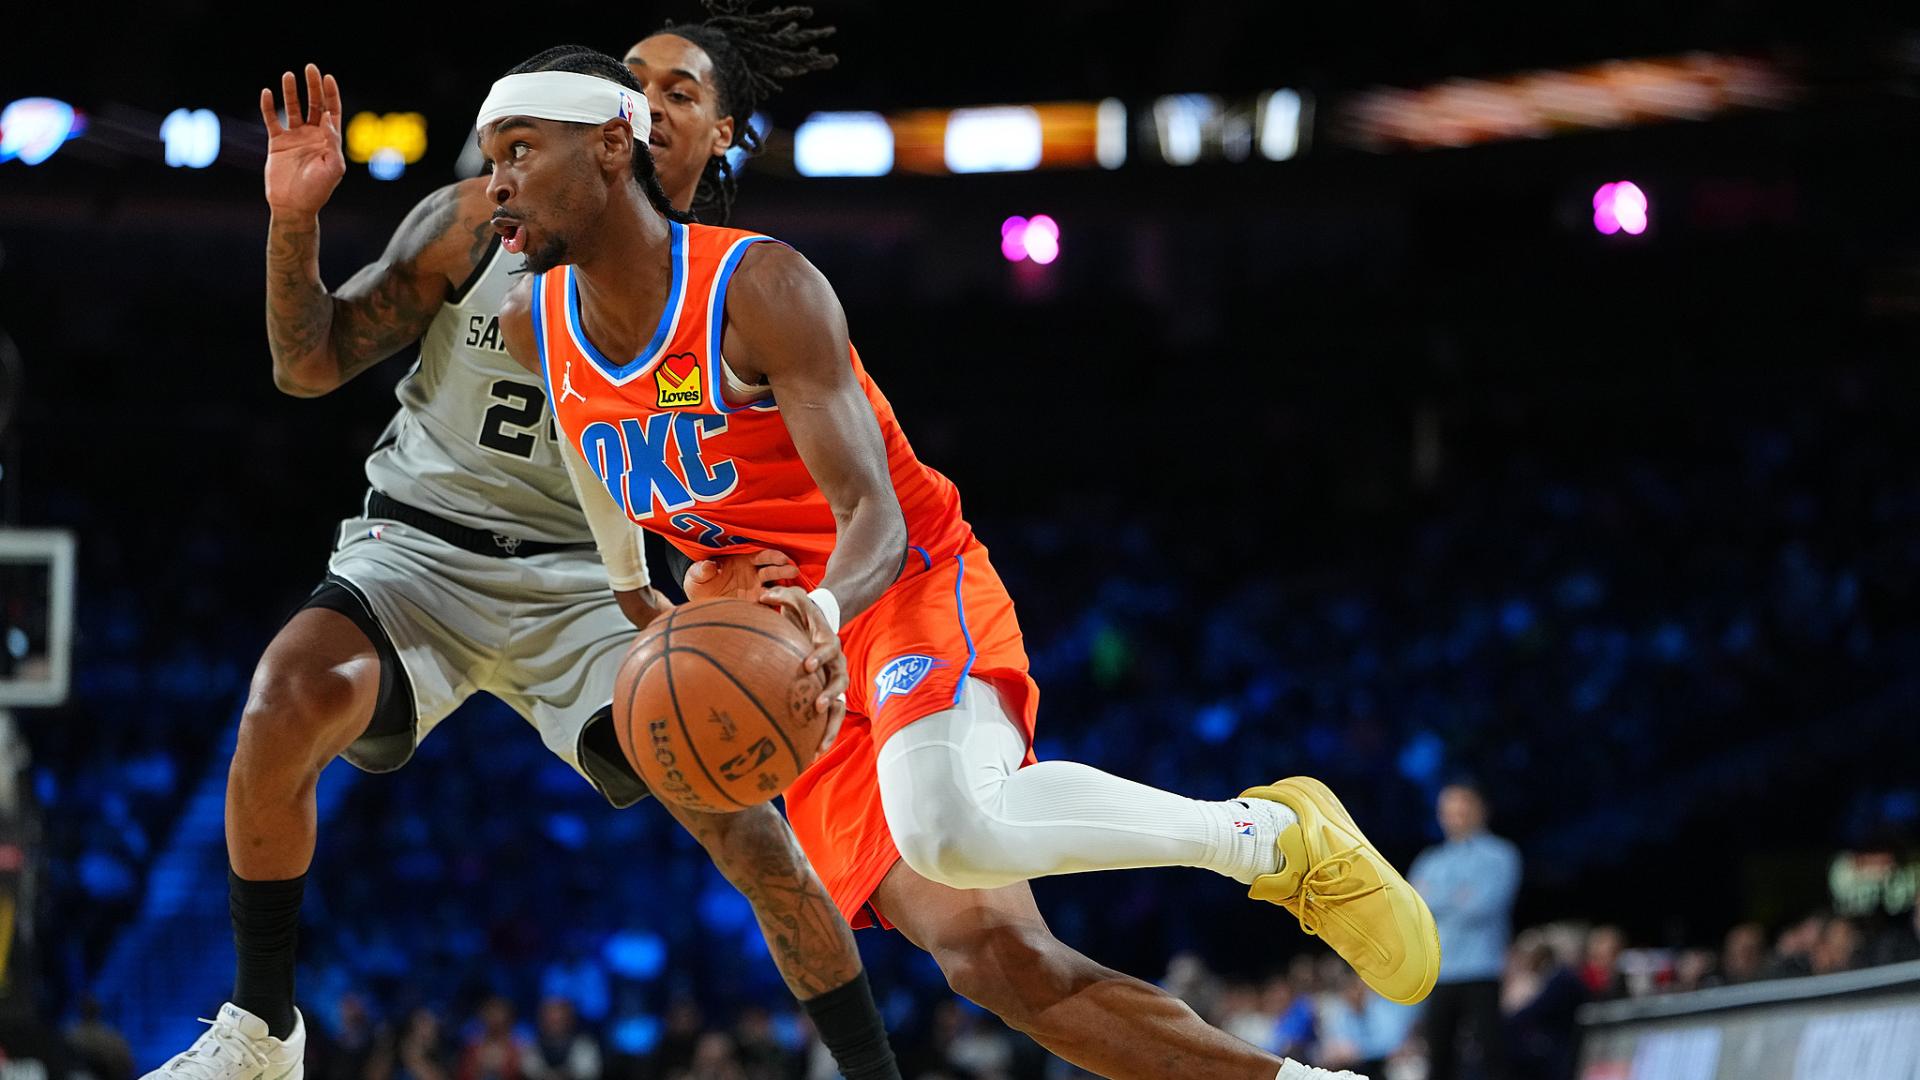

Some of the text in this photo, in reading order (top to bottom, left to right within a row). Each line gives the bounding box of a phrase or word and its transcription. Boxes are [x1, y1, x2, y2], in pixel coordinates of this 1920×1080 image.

[466, 315, 509, 353] SA
[477, 379, 559, 462] 2
[580, 411, 738, 520] OKC
